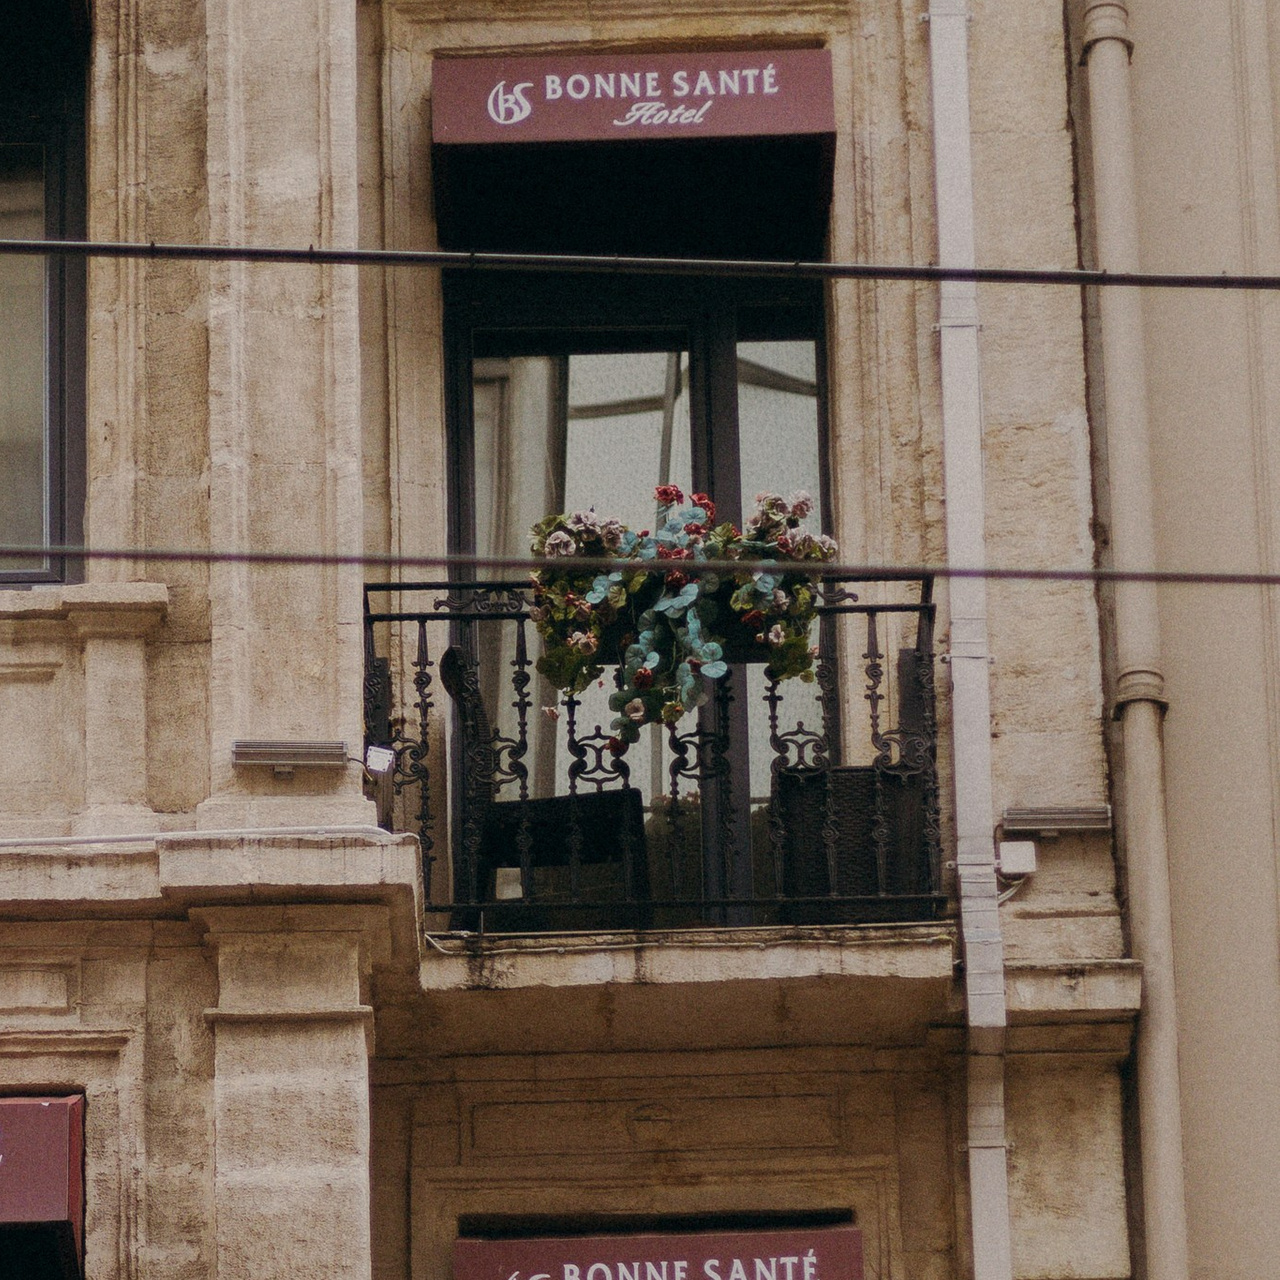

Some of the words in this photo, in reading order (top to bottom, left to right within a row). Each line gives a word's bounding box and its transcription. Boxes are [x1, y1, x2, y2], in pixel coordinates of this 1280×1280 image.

[545, 71, 662, 100] BONNE
[672, 62, 780, 98] SANTÉ
[612, 99, 714, 127] Hotel
